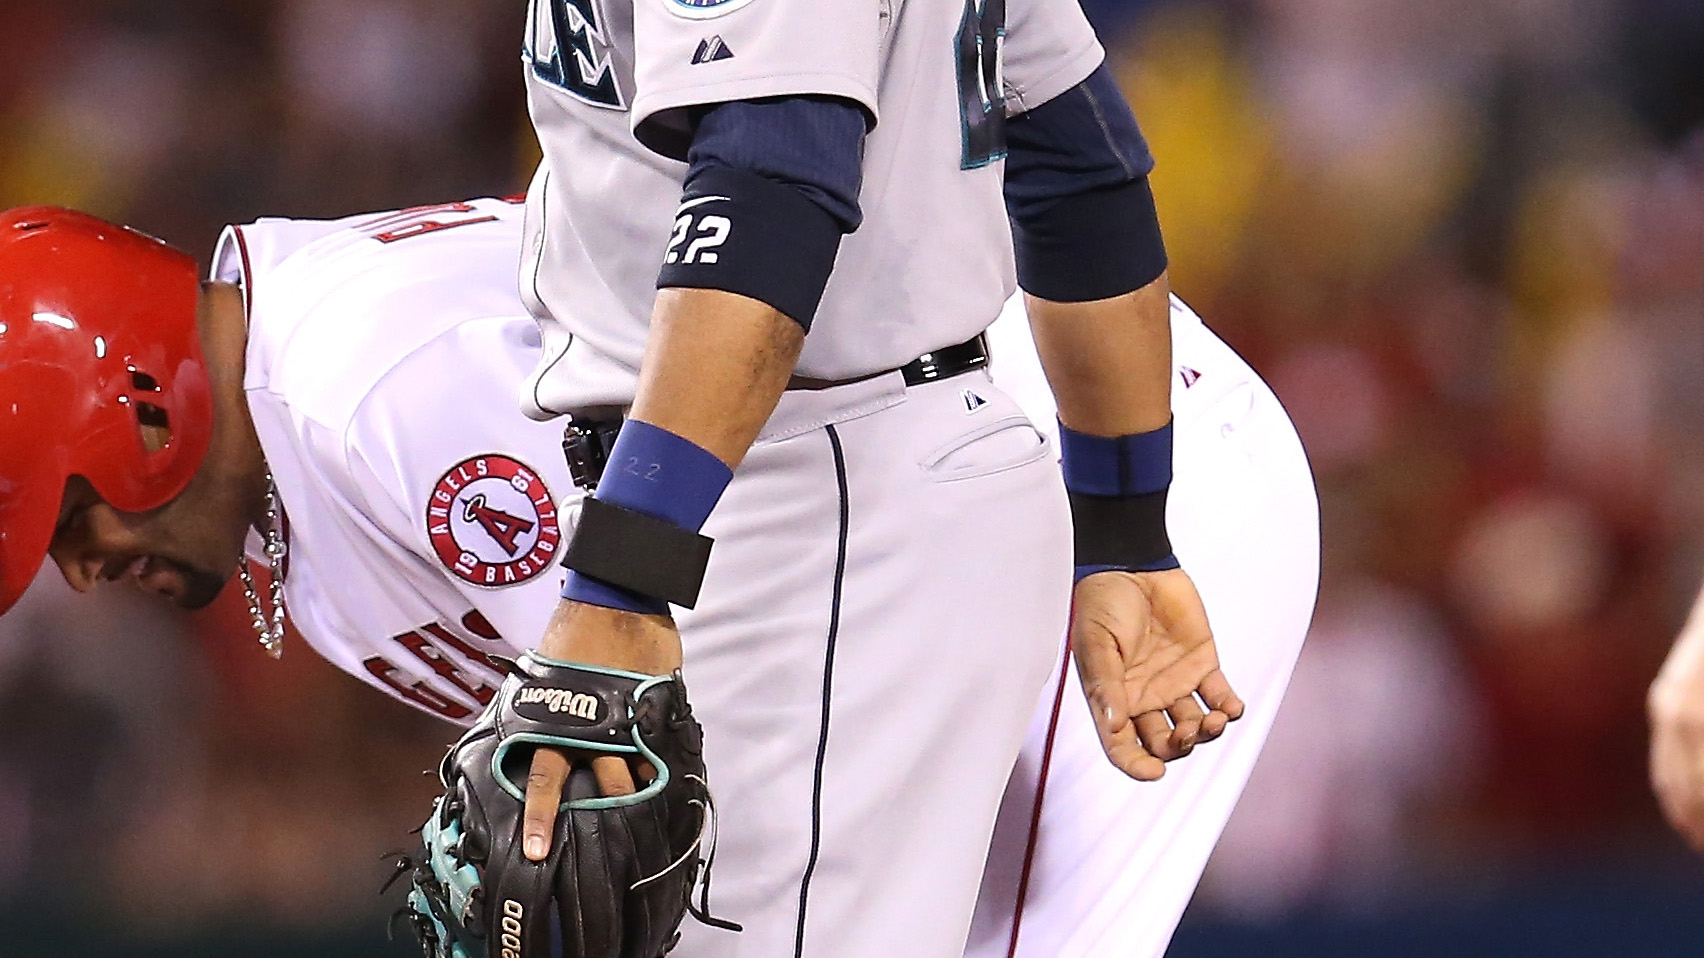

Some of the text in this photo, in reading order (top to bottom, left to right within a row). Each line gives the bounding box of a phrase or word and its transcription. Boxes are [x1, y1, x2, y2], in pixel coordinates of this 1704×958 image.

[663, 213, 732, 265] 22
[430, 459, 488, 535] ANGELS
[459, 494, 536, 558] A
[485, 493, 559, 582] BASEBALL
[517, 686, 599, 721] Wilson
